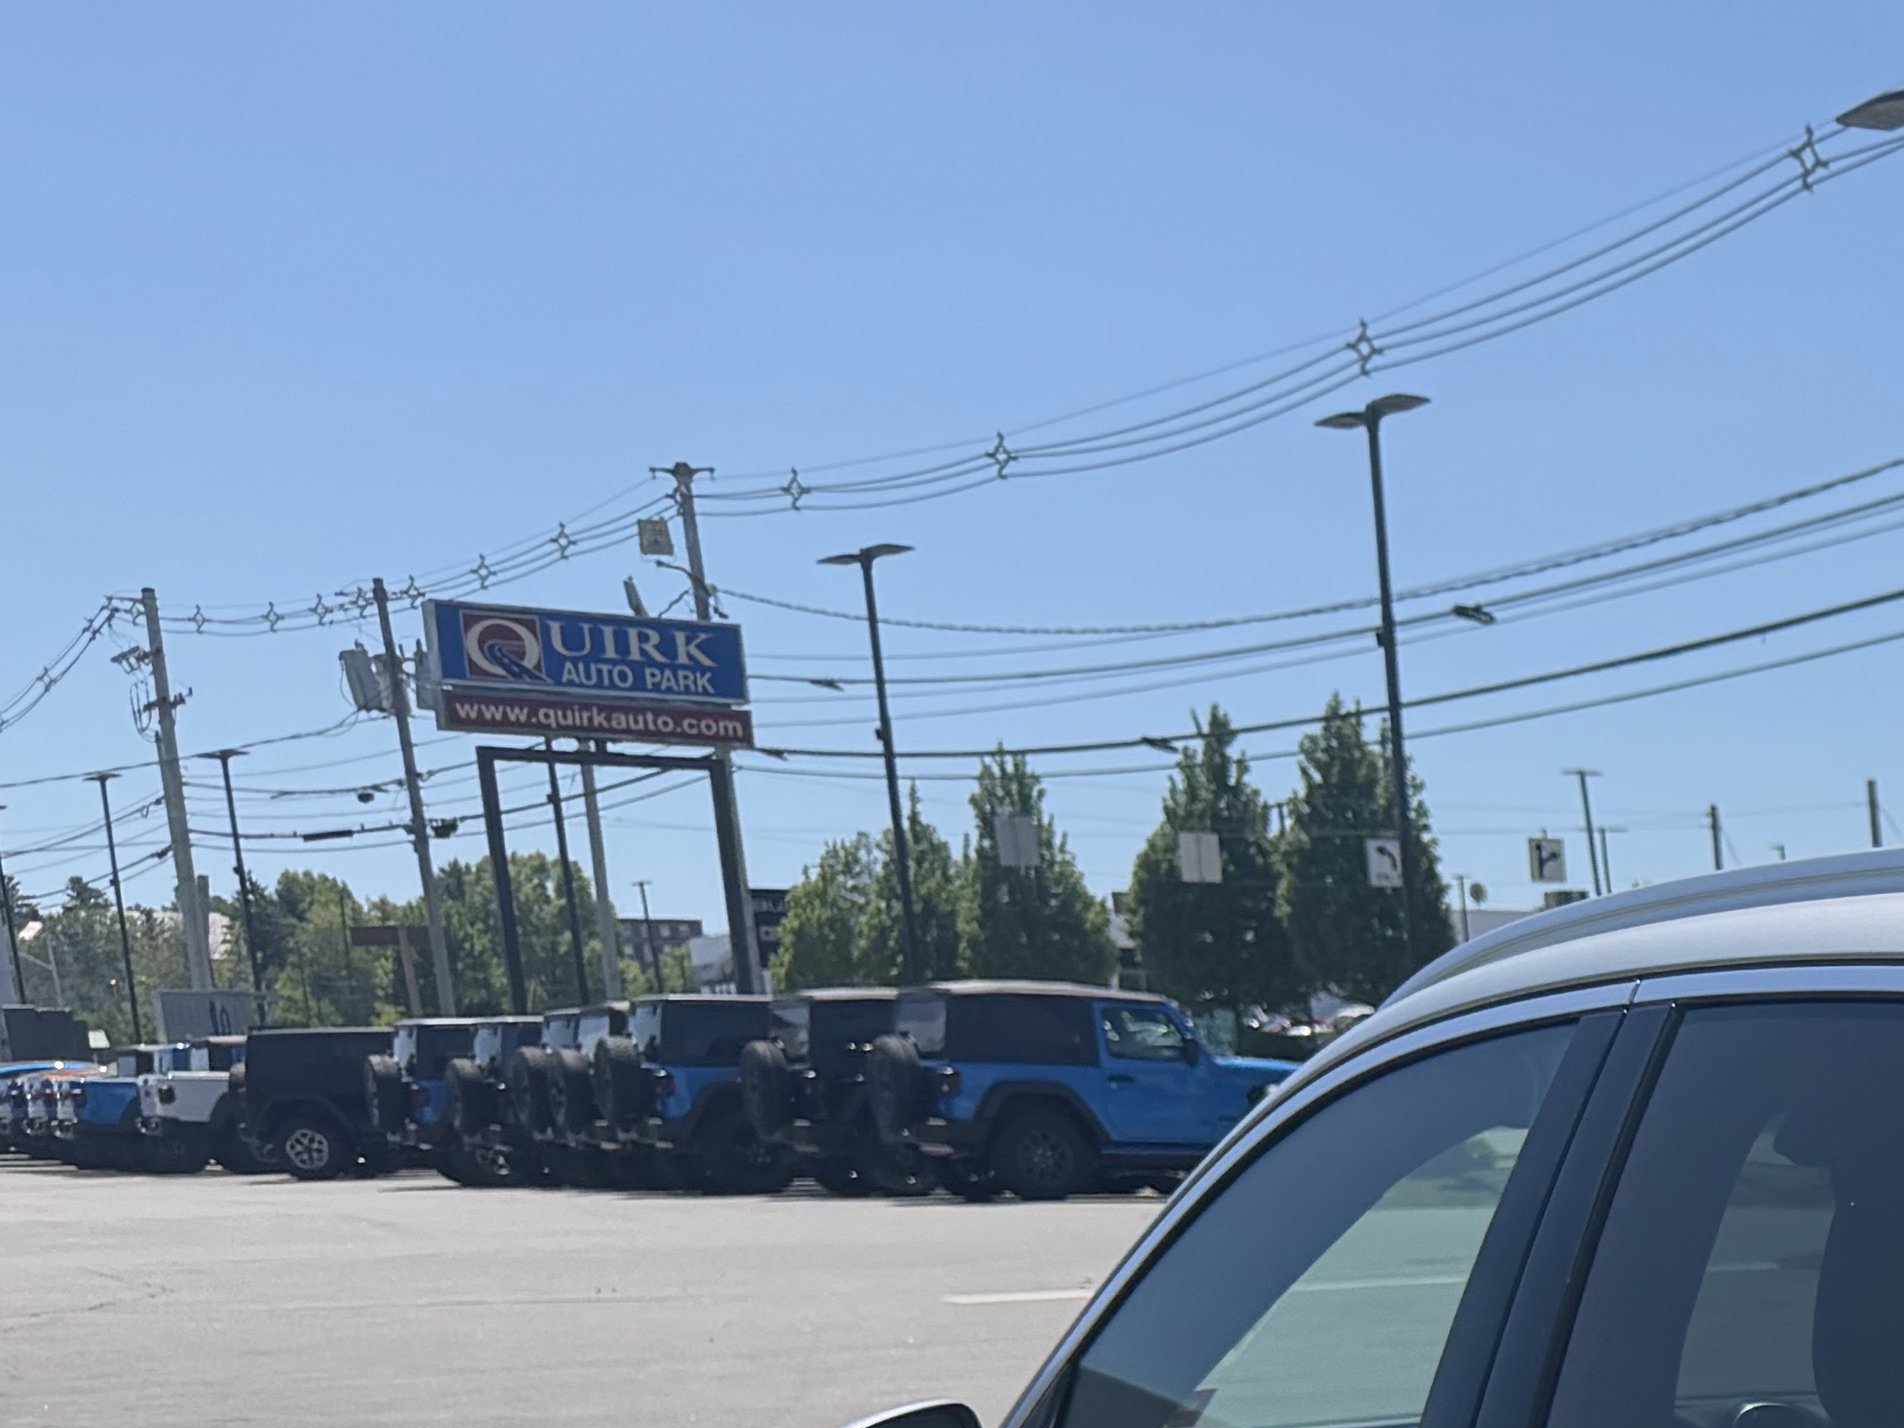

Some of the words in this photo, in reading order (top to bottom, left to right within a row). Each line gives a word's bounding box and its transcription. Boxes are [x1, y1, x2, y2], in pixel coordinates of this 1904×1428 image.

[465, 618, 719, 680] QUIRK
[561, 661, 633, 688] AUTO
[645, 668, 716, 694] PARK
[455, 701, 745, 738] www.quirkauto.com
